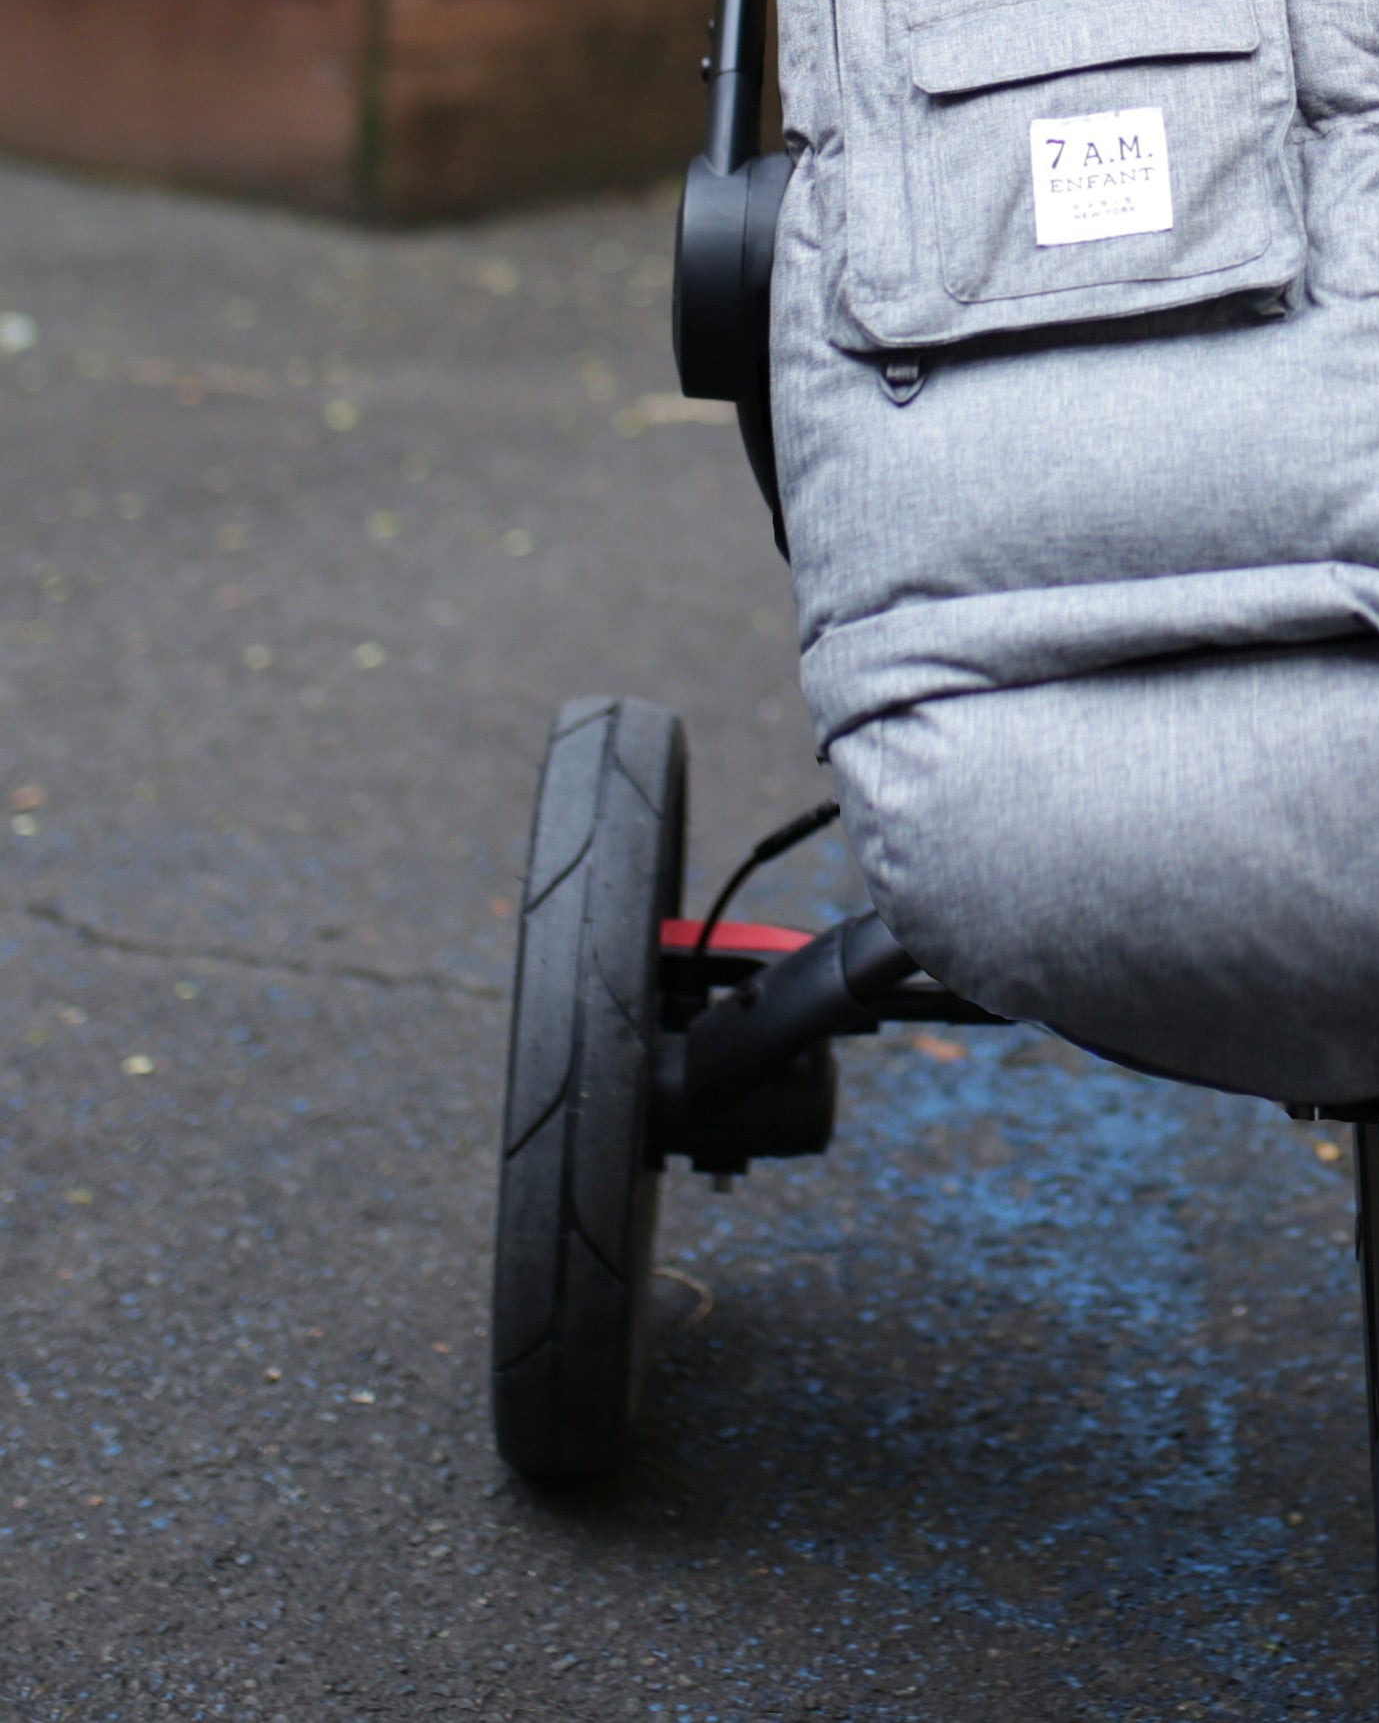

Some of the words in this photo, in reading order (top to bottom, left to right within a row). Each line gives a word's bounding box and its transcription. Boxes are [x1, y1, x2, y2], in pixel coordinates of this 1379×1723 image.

[1045, 138, 1066, 169] 7
[1083, 134, 1153, 167] A.M.
[1049, 167, 1154, 193] ENFANT
